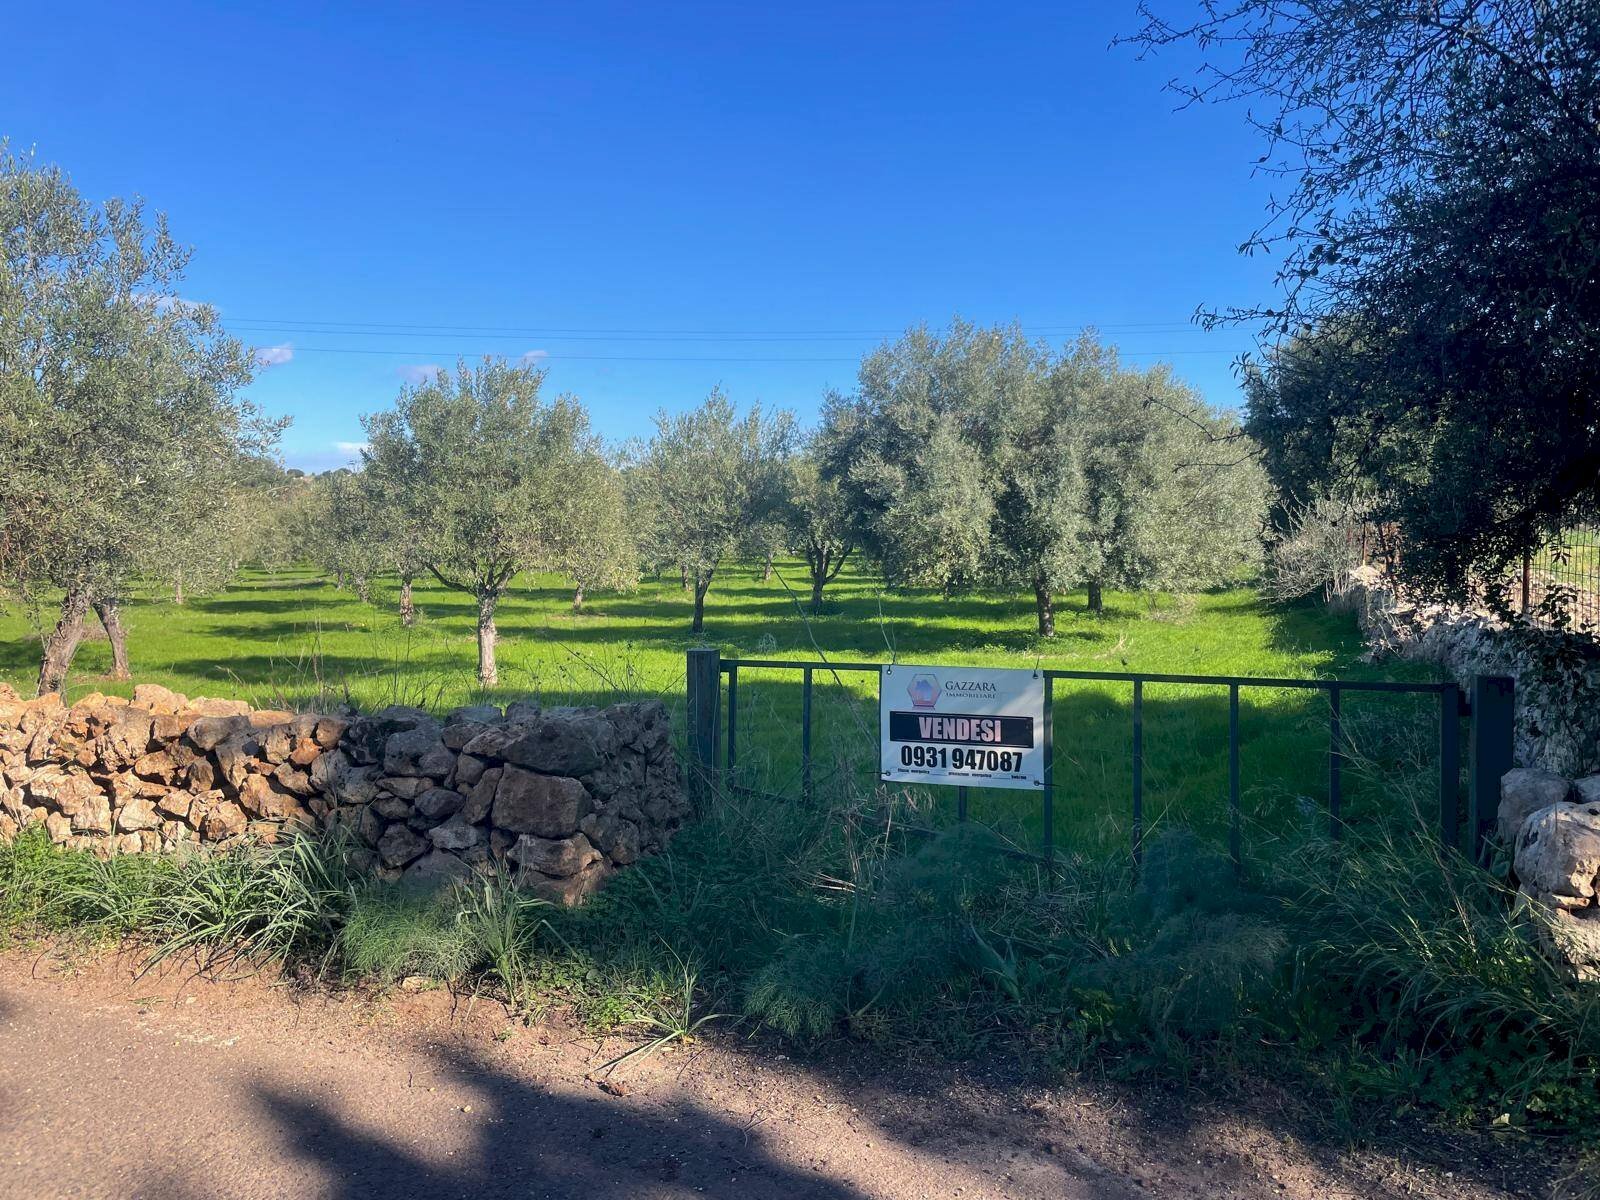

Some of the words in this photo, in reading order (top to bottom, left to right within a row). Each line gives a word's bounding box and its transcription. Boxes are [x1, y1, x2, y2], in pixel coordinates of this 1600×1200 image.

[945, 681, 997, 691] GAZZARA
[918, 716, 1002, 743] VENDESI
[901, 745, 947, 768] 0931
[951, 748, 1023, 772] 947087
